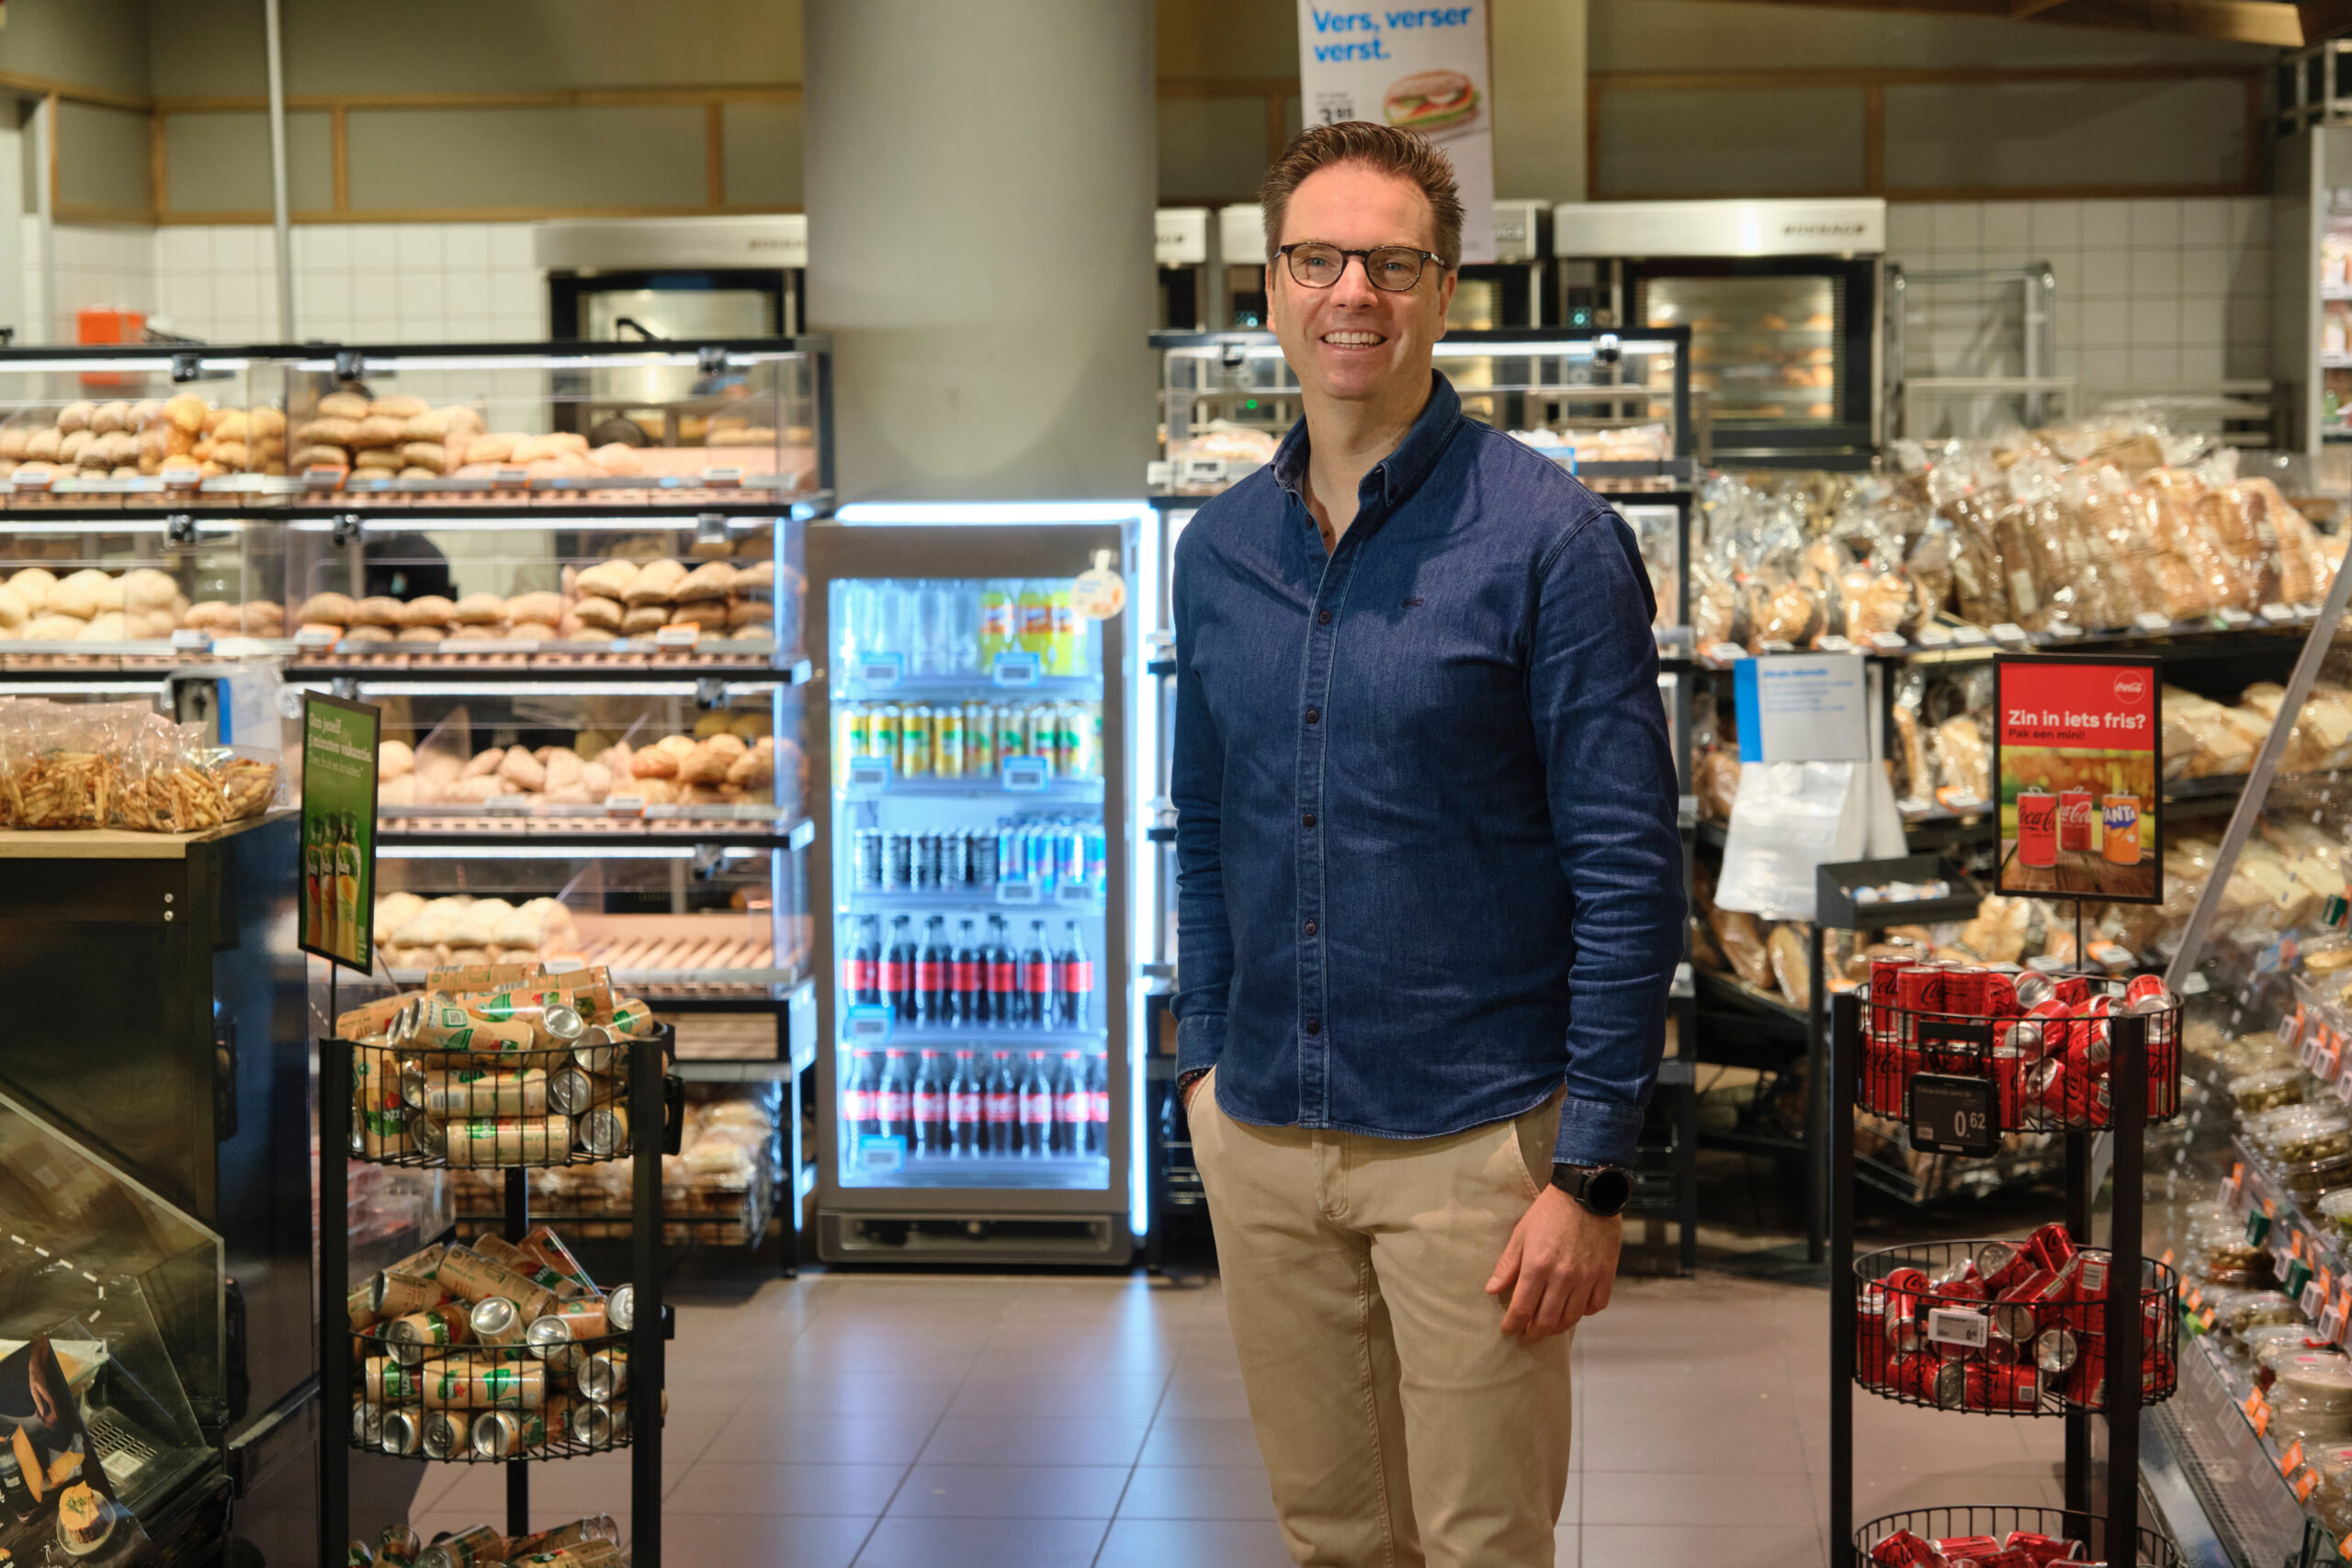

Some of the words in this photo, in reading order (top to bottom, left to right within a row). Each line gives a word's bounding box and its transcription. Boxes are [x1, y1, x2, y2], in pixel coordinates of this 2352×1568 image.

[1312, 10, 1380, 33] Vers,
[1385, 6, 1473, 29] verser
[1314, 39, 1391, 62] verst.
[2008, 709, 2038, 726] Zin
[2042, 710, 2060, 727] in
[2064, 710, 2099, 728] iets
[2104, 712, 2146, 729] fris?
[2008, 728, 2030, 739] Pak
[2033, 730, 2054, 739] een
[2057, 729, 2086, 740] mini!
